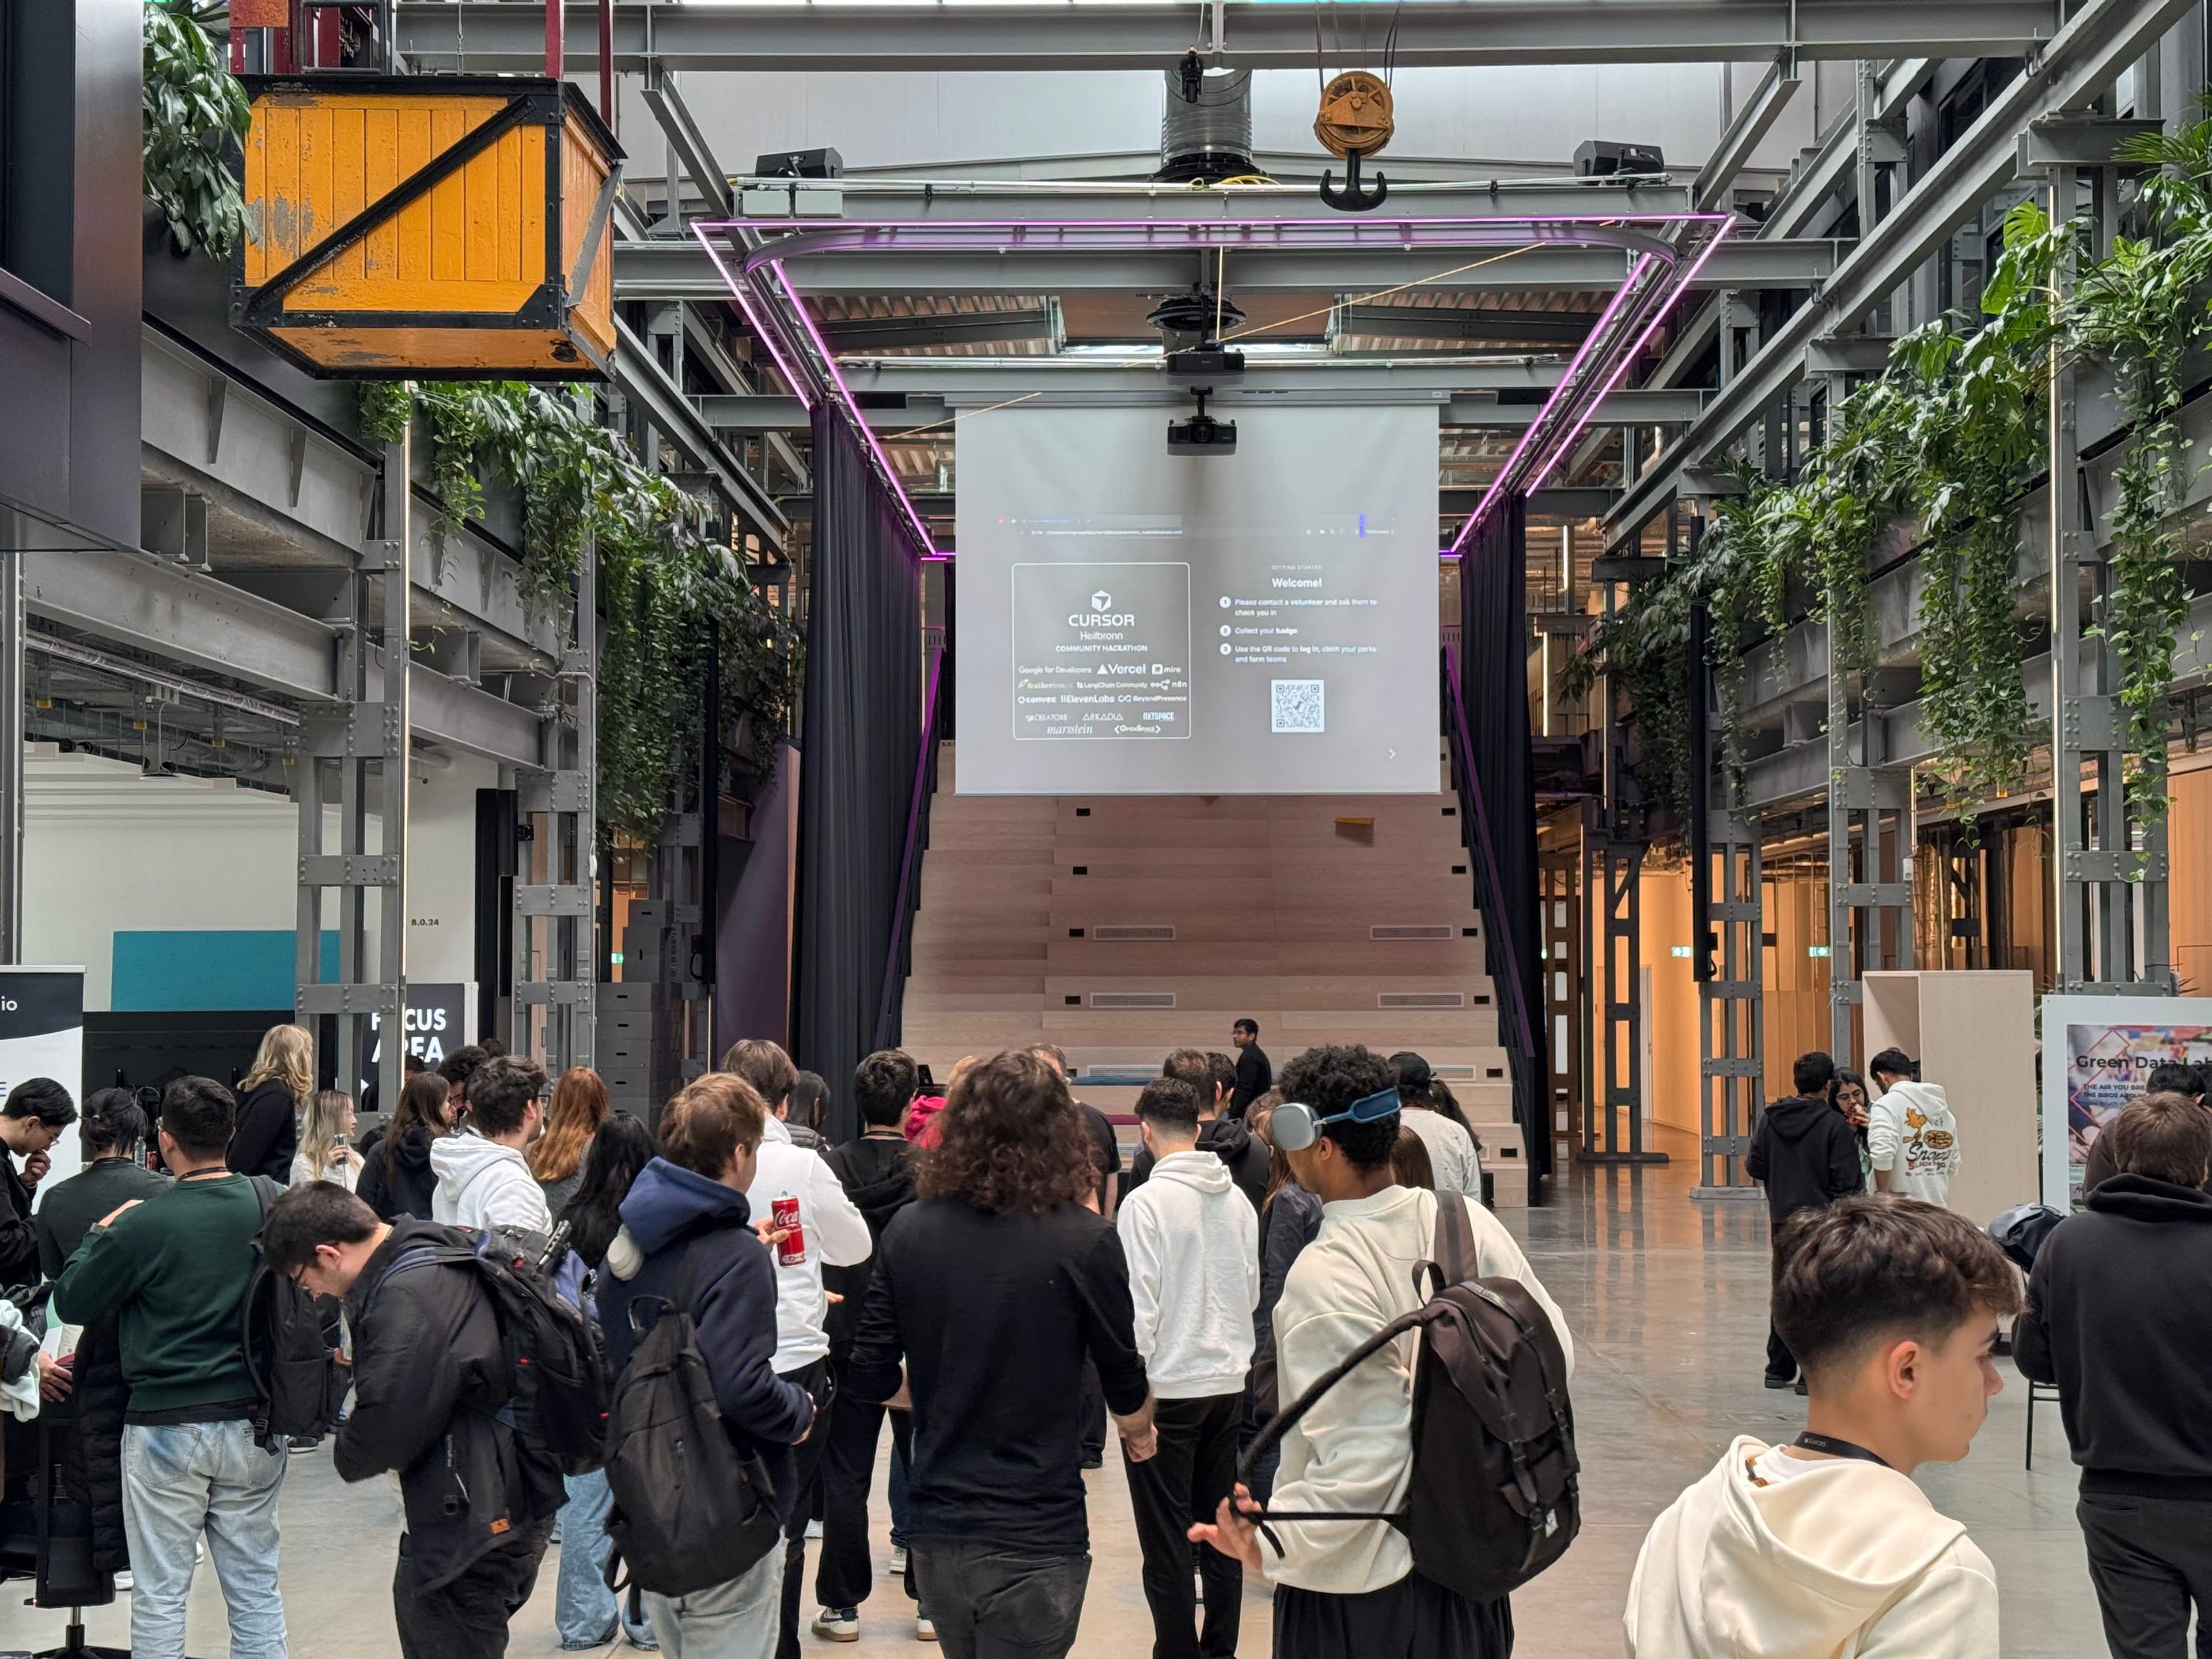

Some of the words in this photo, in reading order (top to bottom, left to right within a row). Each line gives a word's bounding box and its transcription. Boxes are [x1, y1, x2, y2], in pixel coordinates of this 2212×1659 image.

[1271, 578, 1322, 588] Welcome!
[1068, 614, 1135, 627] CURSOR
[1080, 631, 1123, 640] Heilbronn
[1275, 627, 1298, 635] badge
[1300, 645, 1311, 654] log
[1312, 645, 1320, 653] in,
[1357, 646, 1377, 654] perks
[1018, 665, 1043, 675] Google
[1055, 665, 1092, 675] Developers
[1107, 663, 1146, 674] Vercel
[1084, 681, 1115, 690] LangChain
[371, 1008, 446, 1031] FCUS
[2076, 1055, 2130, 1069] Green
